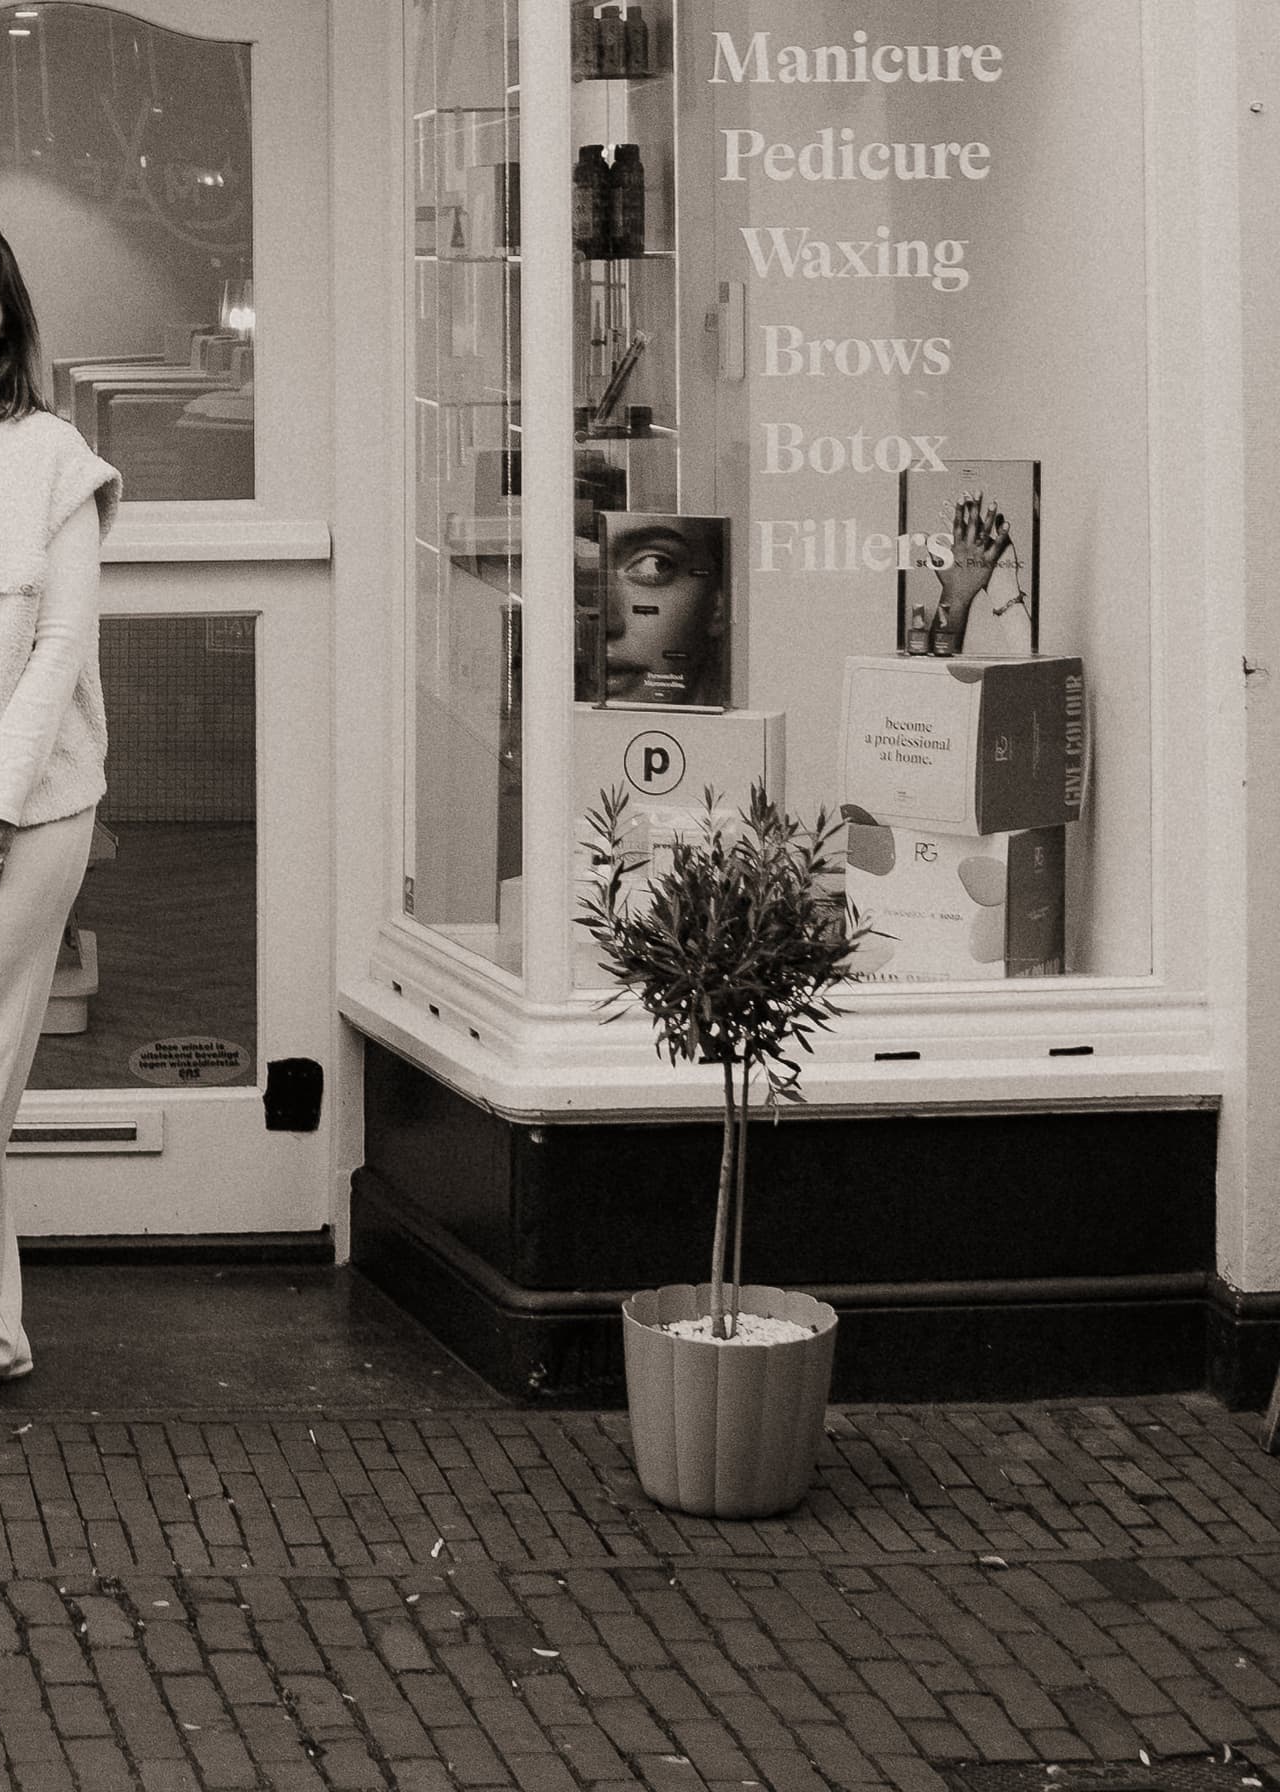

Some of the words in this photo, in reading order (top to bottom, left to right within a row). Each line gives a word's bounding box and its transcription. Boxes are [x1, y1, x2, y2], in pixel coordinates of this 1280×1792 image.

[709, 31, 1004, 84] Manicure
[719, 128, 992, 182] Pedicure
[739, 226, 970, 292] Waxing
[759, 325, 952, 378] Brows
[759, 422, 950, 475] Botox
[753, 518, 956, 573] Fillers
[885, 717, 934, 734] become
[1064, 674, 1083, 757] COLOUR
[644, 746, 670, 783] p
[864, 733, 873, 745] a
[874, 732, 952, 752] professional
[879, 751, 892, 762] at
[896, 750, 934, 766] home.
[139, 1060, 166, 1070] tegen
[141, 1051, 193, 1060] uitstekend
[195, 1050, 240, 1060] beveiligd
[155, 1042, 178, 1051] Deze
[181, 1042, 214, 1051] winkel
[215, 1042, 225, 1050] is
